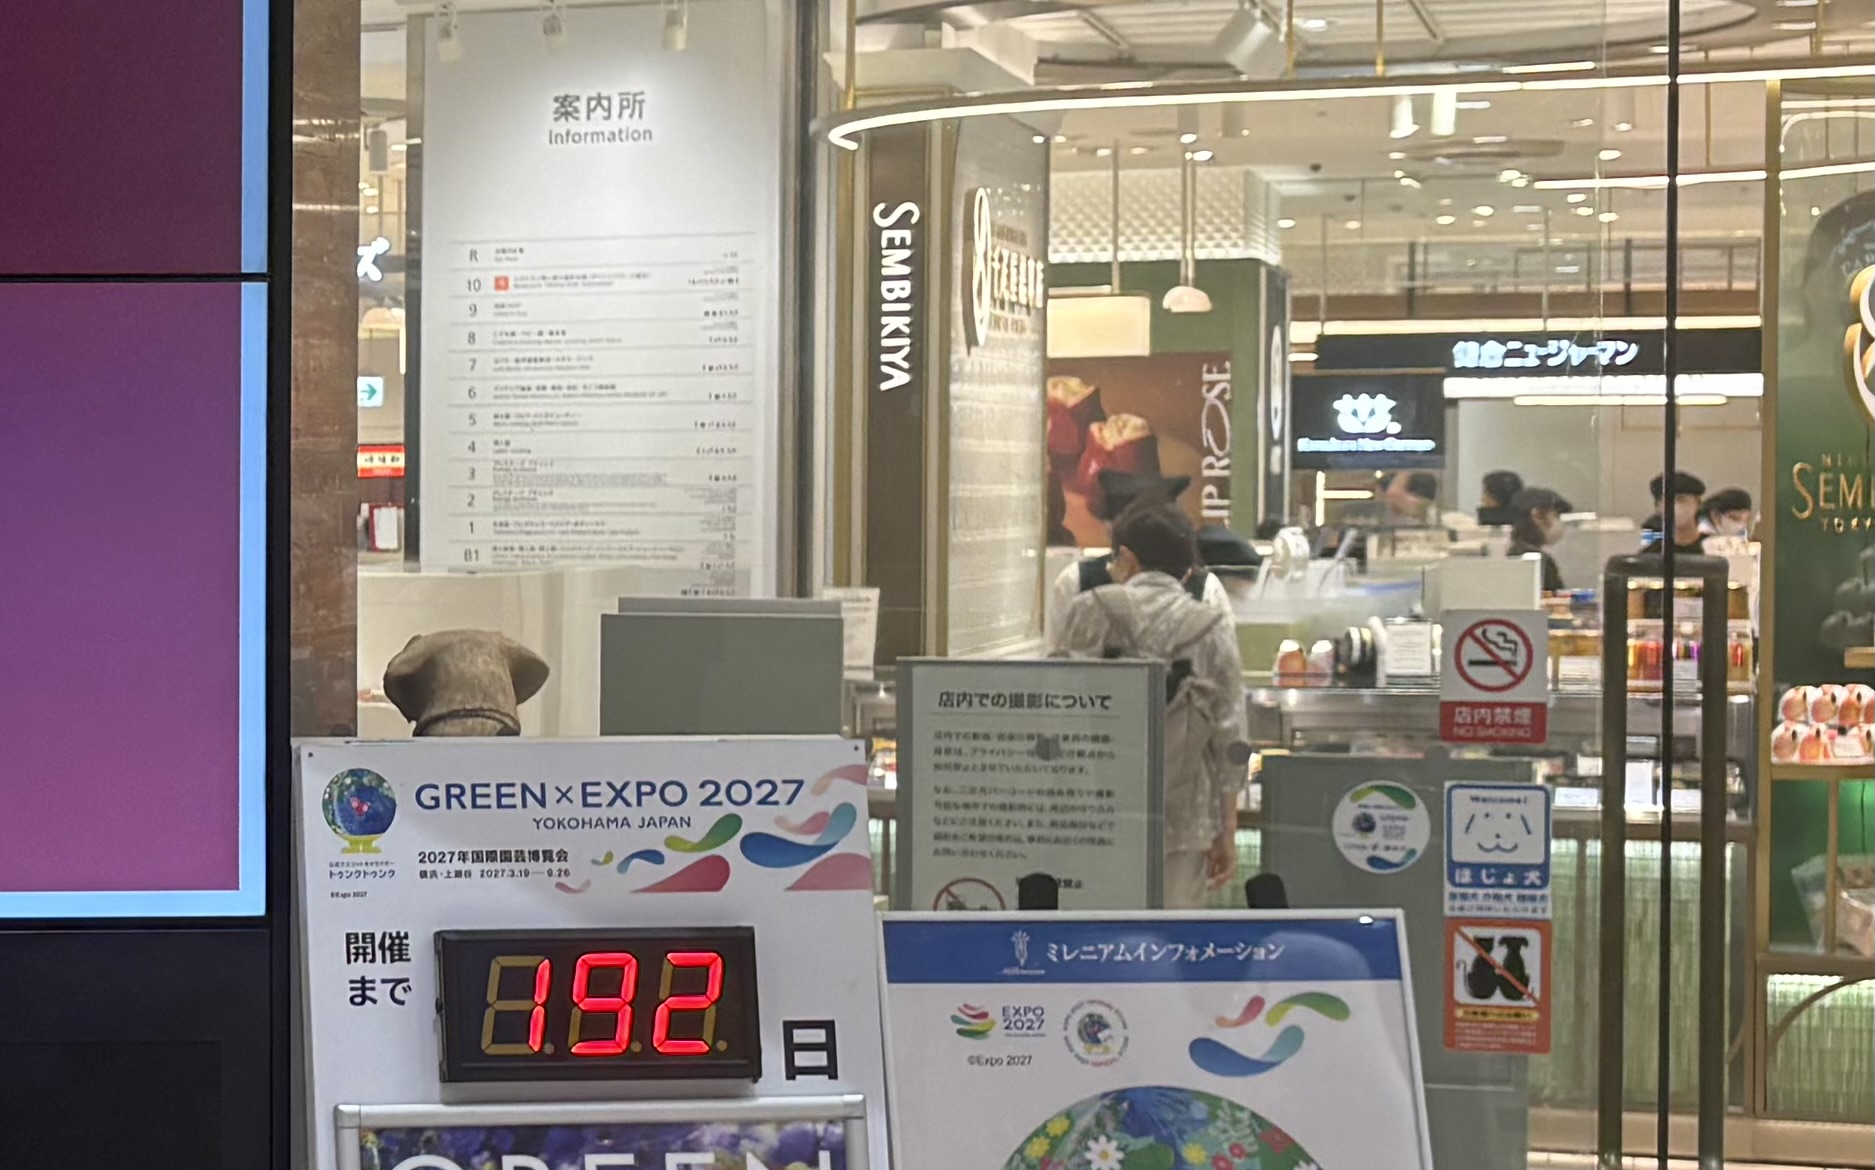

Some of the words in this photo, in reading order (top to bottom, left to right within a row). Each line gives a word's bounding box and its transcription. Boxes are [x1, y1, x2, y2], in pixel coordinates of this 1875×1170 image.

[552, 91, 646, 123] 案内所
[548, 126, 653, 145] Information
[466, 278, 482, 292] 10
[872, 201, 920, 391] SEMBIKIYA
[468, 304, 478, 317] 9
[467, 331, 477, 345] 8
[468, 358, 478, 371] 7
[467, 386, 477, 399] 6
[468, 413, 477, 426] 5
[467, 440, 477, 453] 4
[1791, 461, 1875, 520] SEM
[467, 494, 476, 507] 2
[469, 521, 474, 534] 1
[938, 691, 1113, 711] 店内での撮影について
[1454, 705, 1532, 726] 店内禁煙
[699, 779, 805, 807] 2027
[531, 816, 632, 831] YOKOHAMA
[637, 815, 693, 831] JAPAN
[417, 848, 569, 865] 2027年国際園芸博覧会
[329, 869, 396, 880] トゥンクトゥンク
[1454, 867, 1542, 886] ほじょ犬
[344, 931, 412, 965] 開催
[1046, 941, 1285, 962] ミレニアムインフォメーション
[347, 975, 412, 1007] まで
[528, 950, 725, 1055] 192
[1001, 1005, 1045, 1018] EXPO
[1003, 1018, 1045, 1031] 2027
[782, 1019, 839, 1081] 日
[1006, 1055, 1032, 1066] 2027
